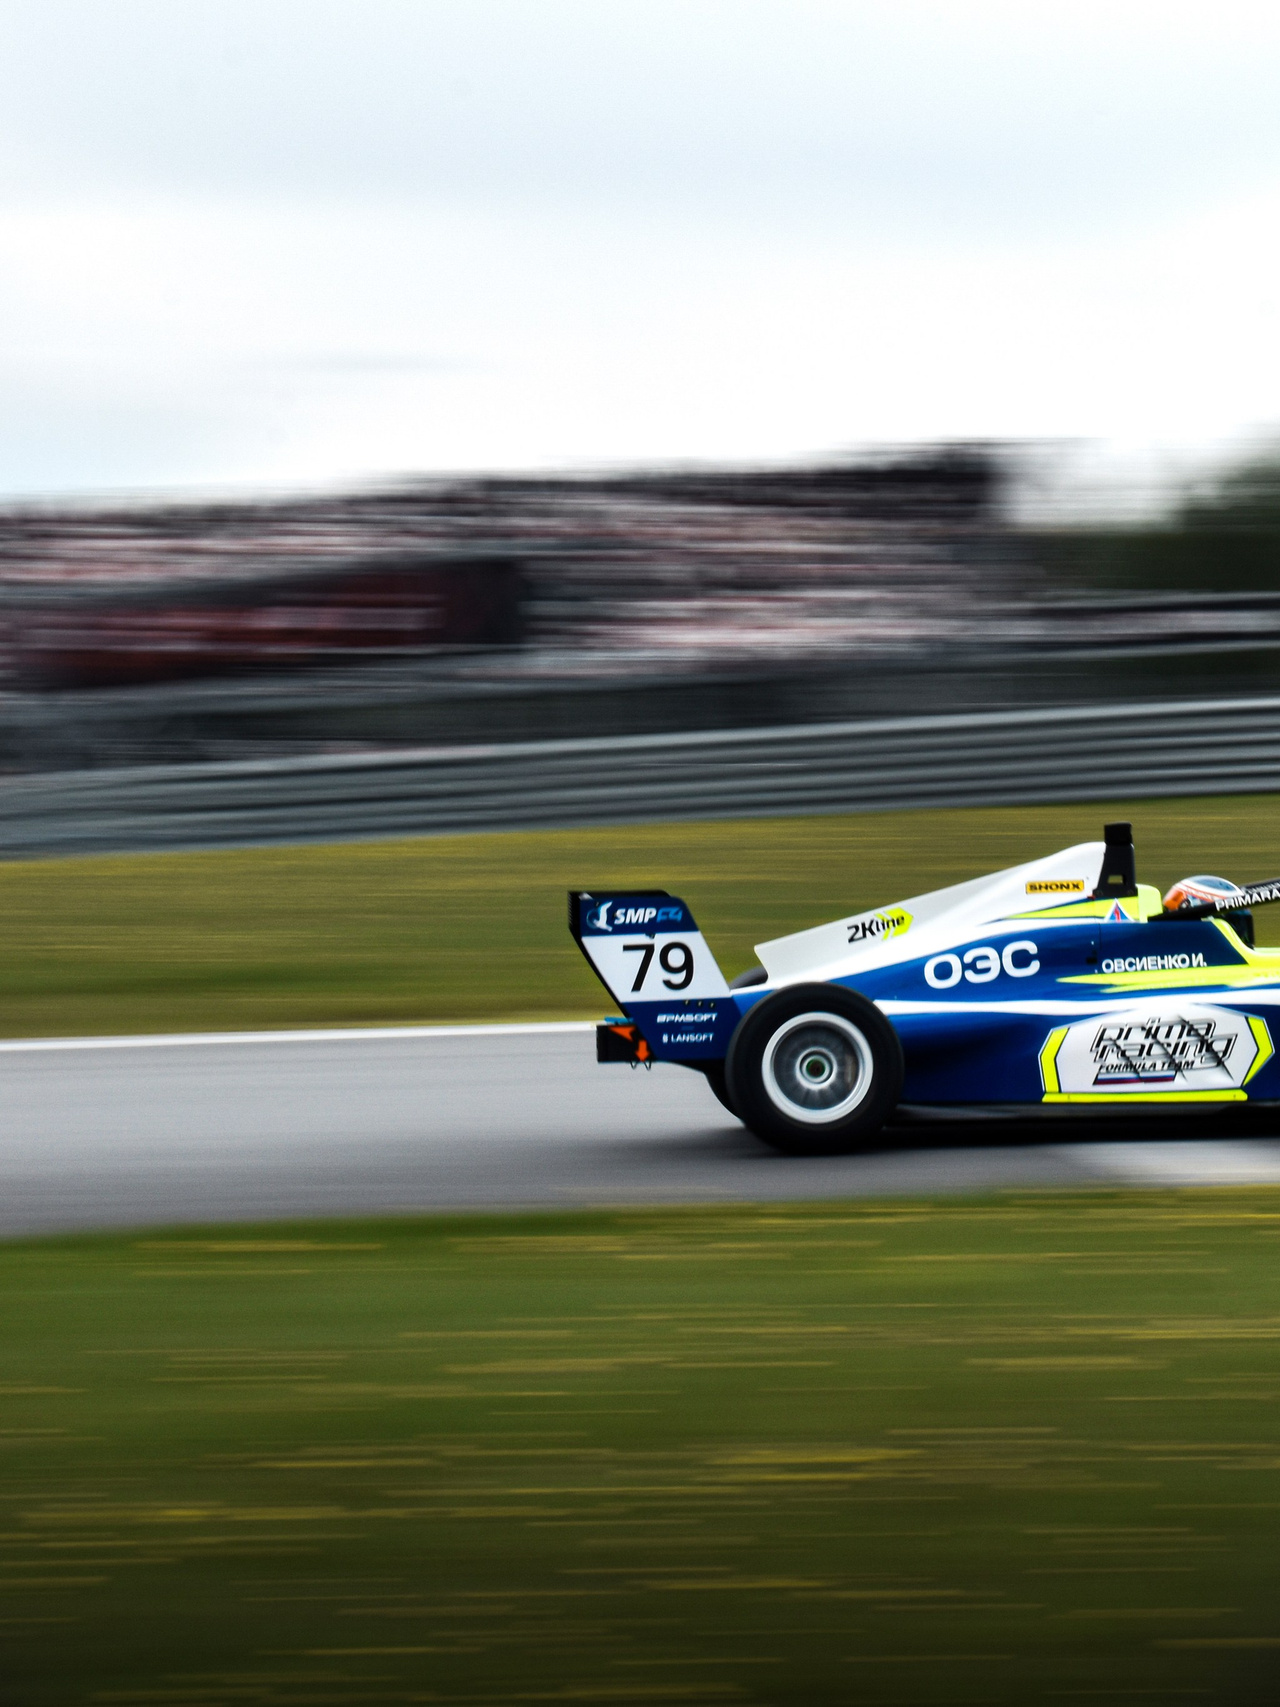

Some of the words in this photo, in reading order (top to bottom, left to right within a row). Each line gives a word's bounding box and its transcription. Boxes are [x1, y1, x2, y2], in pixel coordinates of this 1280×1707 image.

[1029, 881, 1081, 892] SHONX
[622, 941, 694, 992] 79
[924, 940, 1040, 989] ОЭС
[1102, 955, 1190, 974] ОВСИЕНКО
